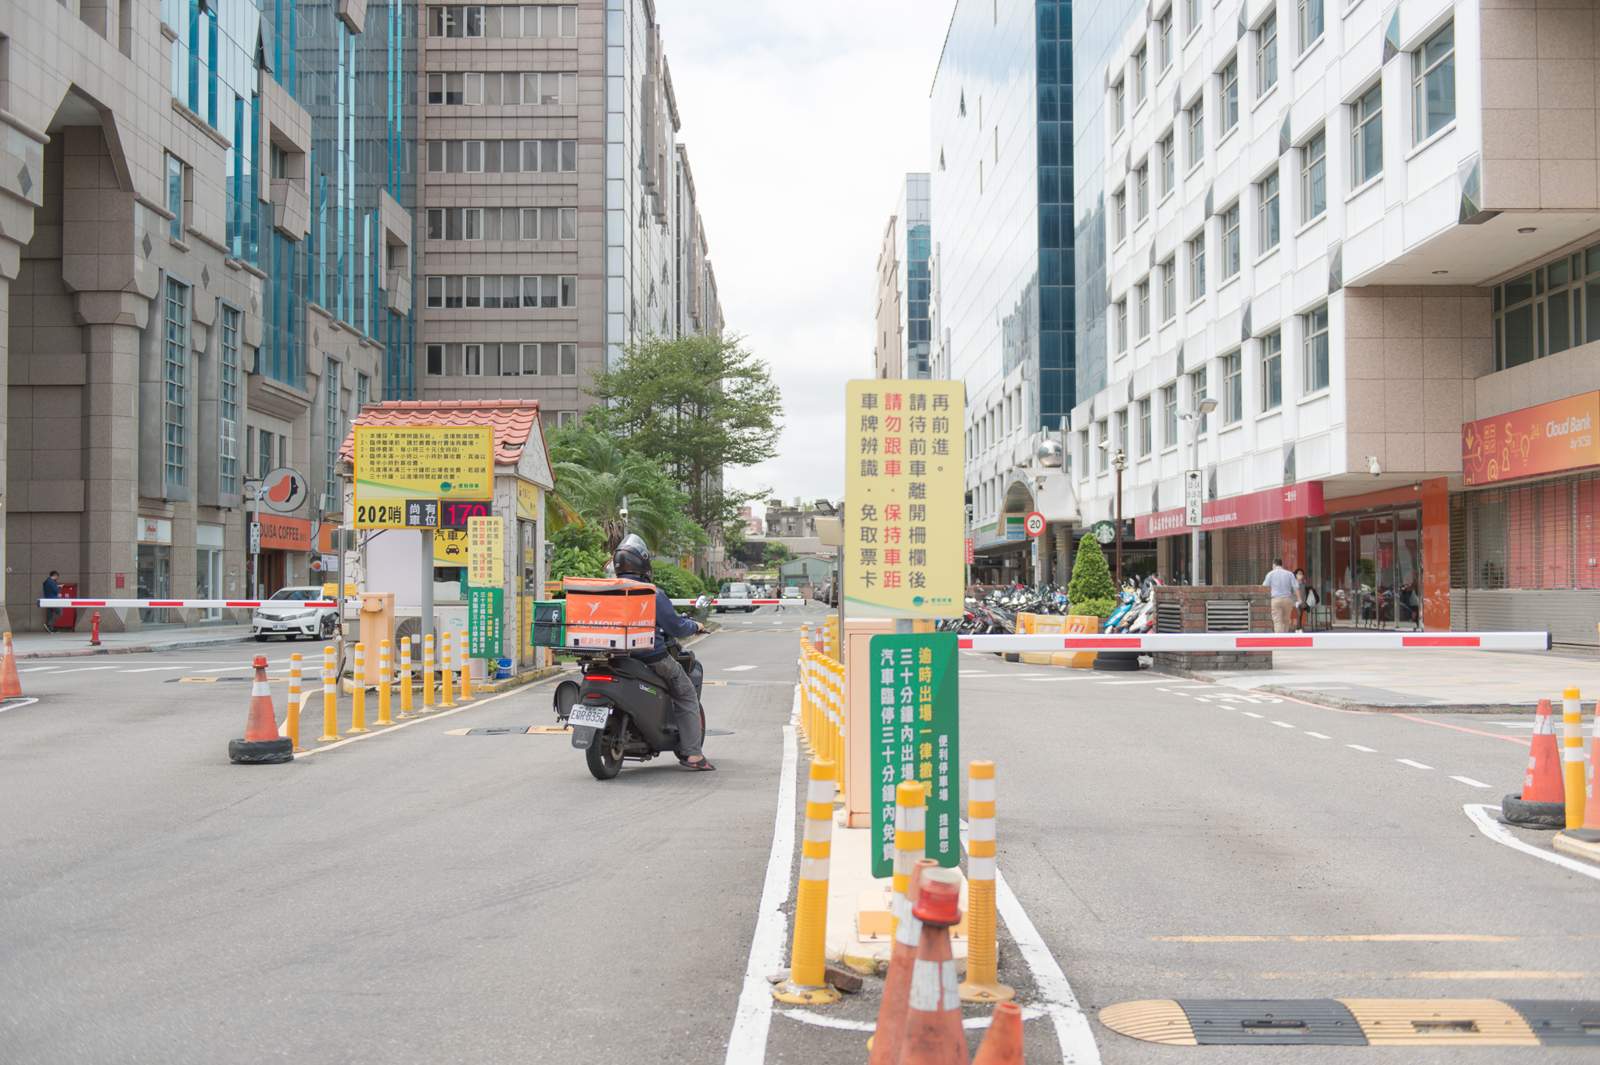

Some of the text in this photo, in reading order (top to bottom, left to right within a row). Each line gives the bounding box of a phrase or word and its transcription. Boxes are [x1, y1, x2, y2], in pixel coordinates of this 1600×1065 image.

[1545, 411, 1592, 438] Cloud Bank
[908, 393, 927, 589] 請待前車離開柵欄後
[358, 505, 402, 524] 202哨
[1030, 519, 1041, 529] 20
[278, 524, 299, 541] COFFEE
